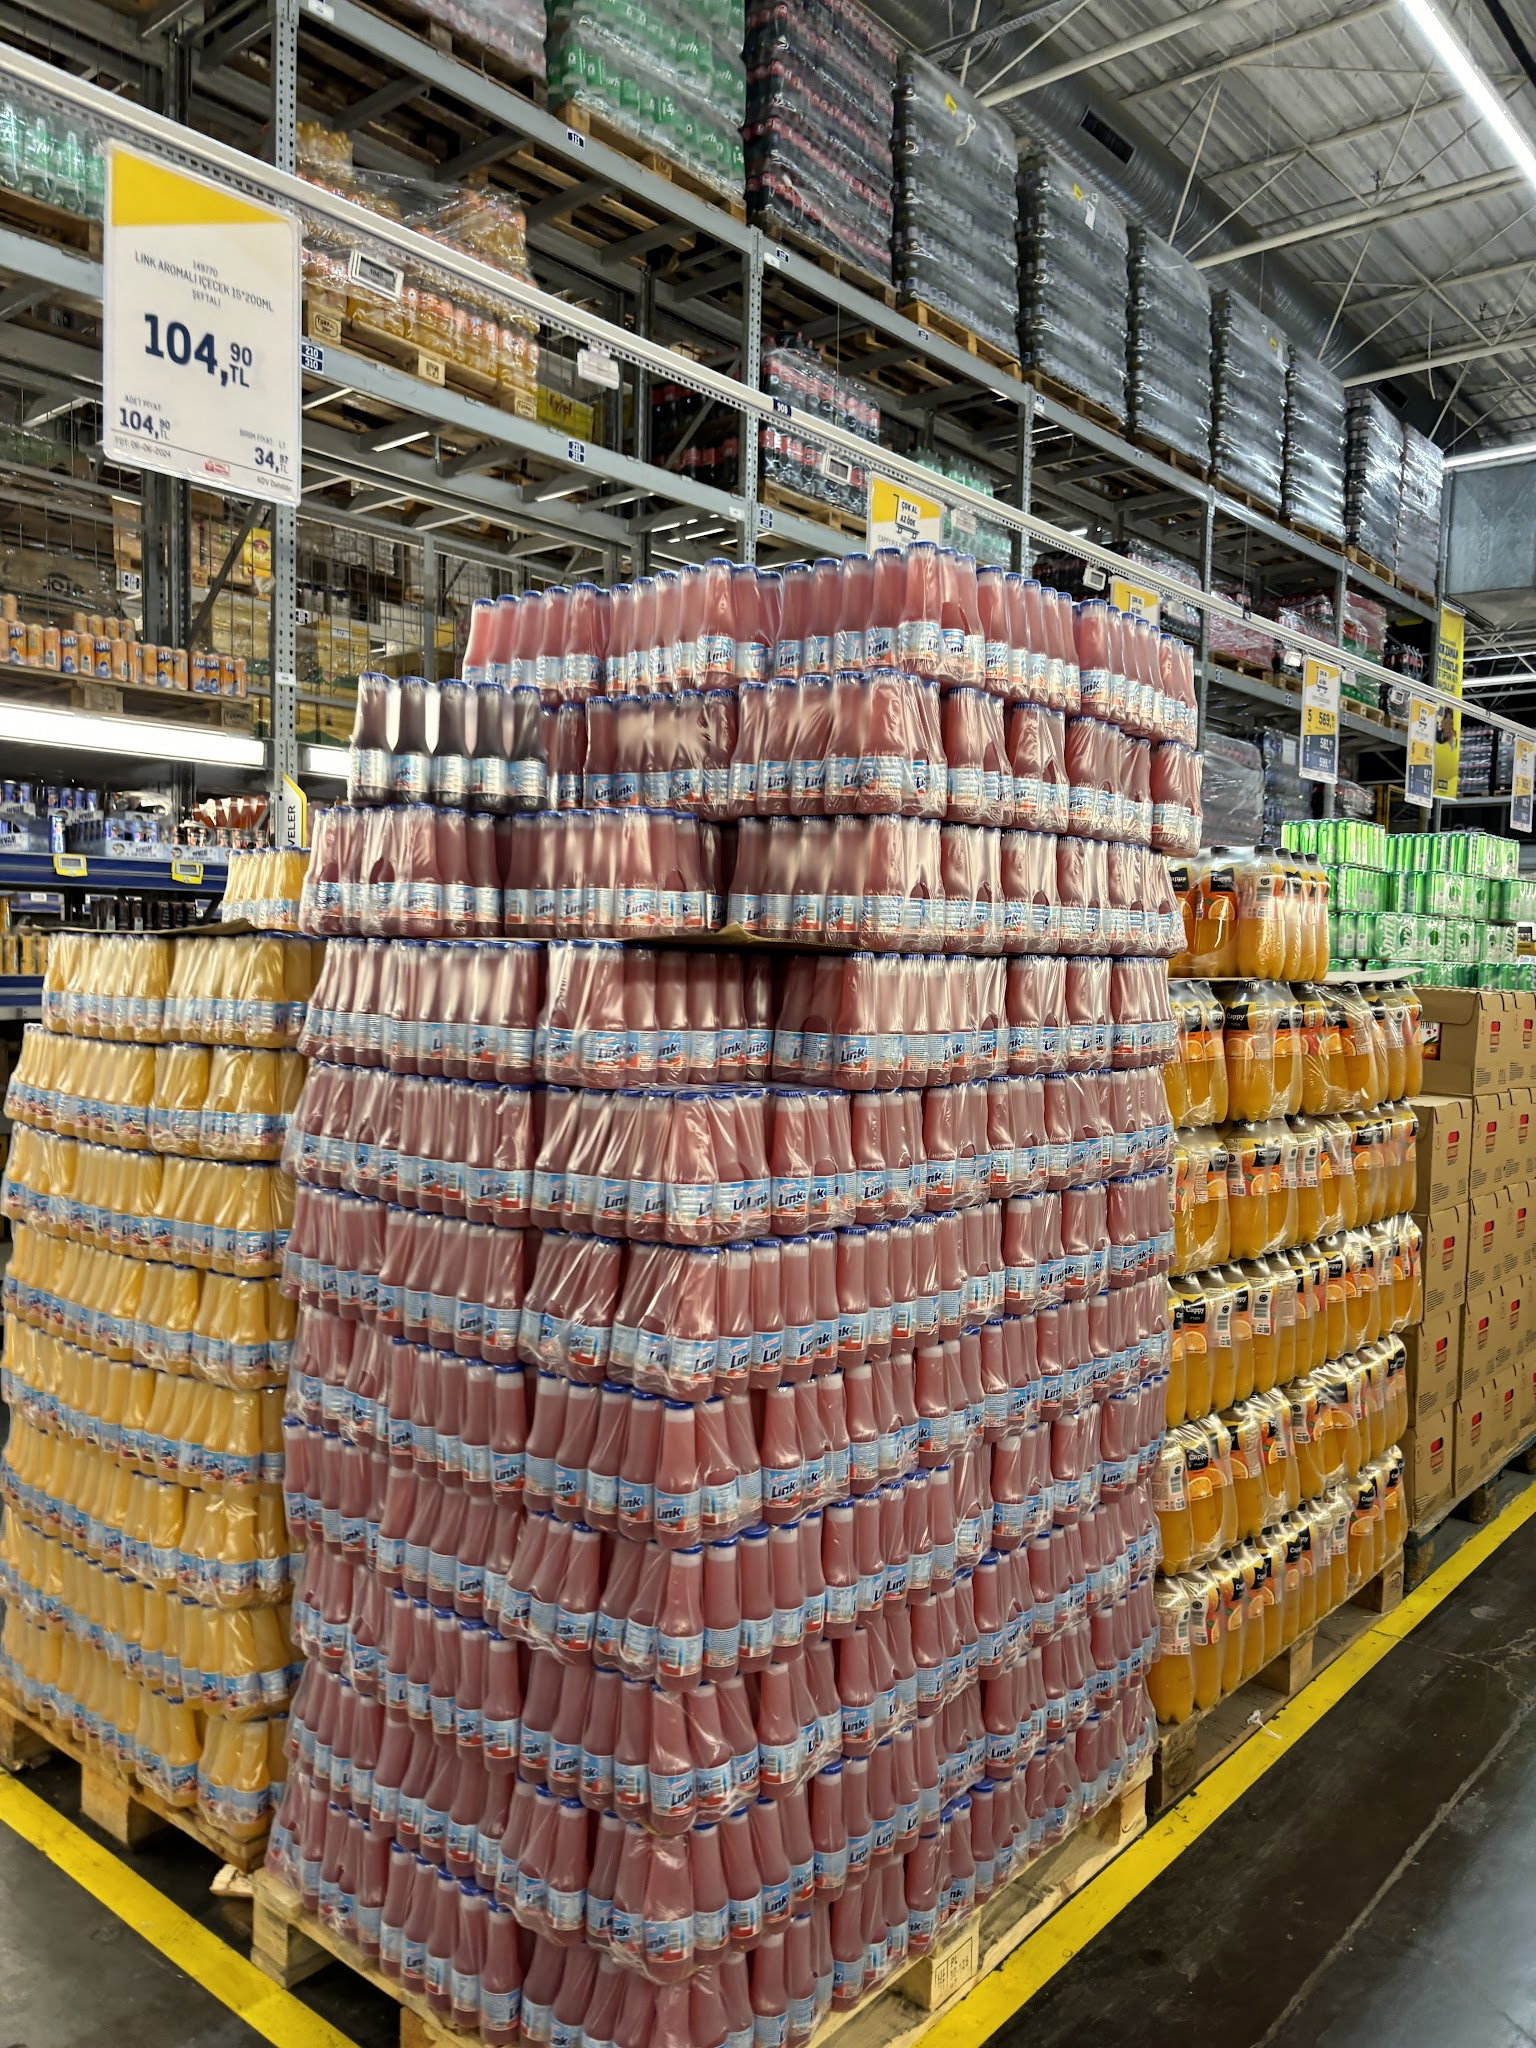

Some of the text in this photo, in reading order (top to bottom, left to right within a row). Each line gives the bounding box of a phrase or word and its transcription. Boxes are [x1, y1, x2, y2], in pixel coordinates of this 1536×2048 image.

[135, 250, 156, 268] LINK
[158, 259, 198, 283] AROMALI
[144, 312, 252, 388] 104, 90
[305, 346, 319, 358] 210
[305, 357, 319, 370] 310
[229, 364, 250, 388] TL
[119, 407, 170, 439] 104, 90
[160, 429, 170, 440] TL
[254, 446, 289, 474] 34, 97
[901, 501, 918, 514] ÇOK AL
[868, 639, 889, 656] Link
[1081, 680, 1100, 694] ink
[395, 768, 411, 780] ink
[767, 774, 788, 788] Lin
[805, 774, 824, 788] Lin
[595, 788, 612, 799] Lin
[614, 784, 634, 799] ink
[1170, 876, 1187, 884] appy
[625, 901, 650, 915] Link
[1226, 1012, 1246, 1022] Cappy
[659, 1041, 680, 1057] ink
[841, 1047, 865, 1062] Link
[926, 1171, 943, 1184] nk
[605, 1196, 627, 1208] Lin
[645, 1198, 664, 1212] Lin
[778, 1192, 803, 1207] Link
[699, 1200, 712, 1216] Lin
[323, 1279, 337, 1290] Lin
[1185, 1306, 1205, 1315] Cappy
[815, 1333, 830, 1346] nk
[763, 1347, 781, 1363] Lin
[800, 1340, 814, 1356] Lin
[730, 1352, 750, 1368] Lin
[803, 1472, 819, 1487] nk
[1101, 1473, 1121, 1483] Link
[556, 1481, 575, 1492] ink
[771, 1481, 797, 1499] Link
[658, 1506, 681, 1520] Link
[513, 1607, 530, 1619] Lin
[557, 1624, 574, 1636] ink
[522, 1743, 542, 1754] ink
[991, 1747, 1011, 1758] Link
[876, 1831, 893, 1846] Lin
[850, 1847, 867, 1863] Lin
[950, 1889, 962, 1898] nk
